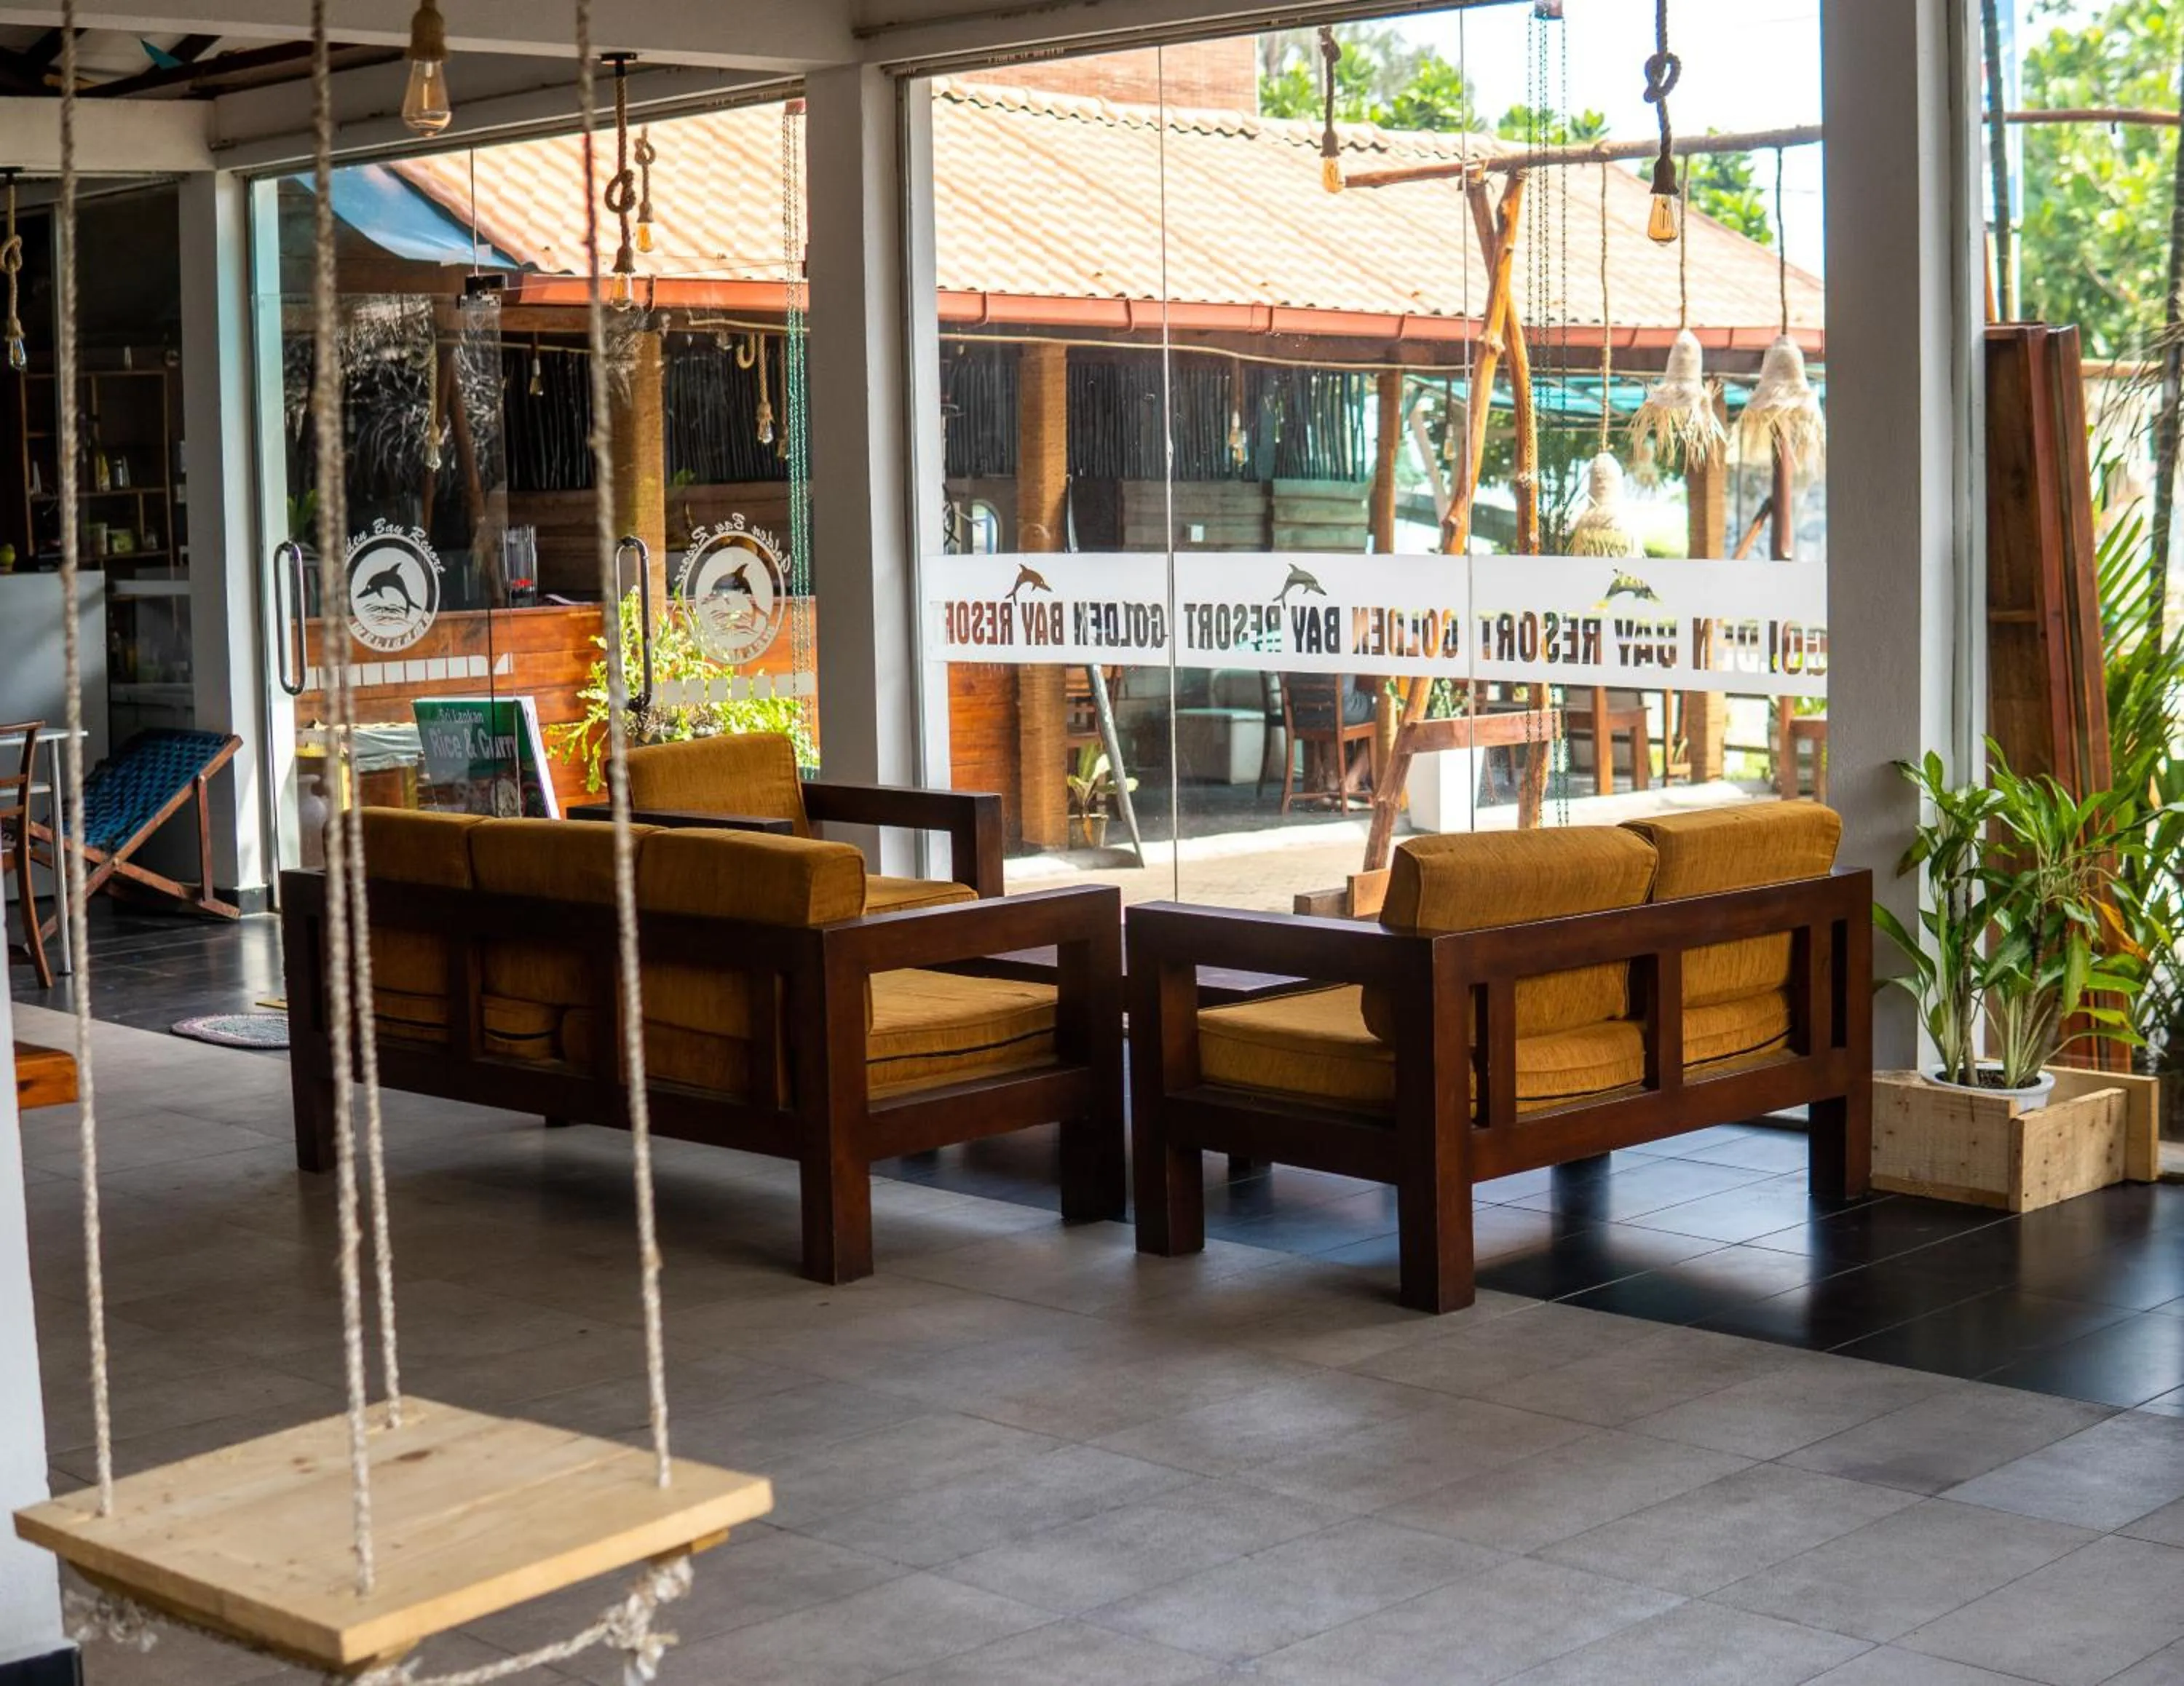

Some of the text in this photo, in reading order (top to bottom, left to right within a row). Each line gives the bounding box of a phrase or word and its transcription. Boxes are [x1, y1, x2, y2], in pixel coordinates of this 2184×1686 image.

[373, 518, 404, 534] Bay
[428, 728, 463, 759] Rice
[464, 727, 478, 759] &
